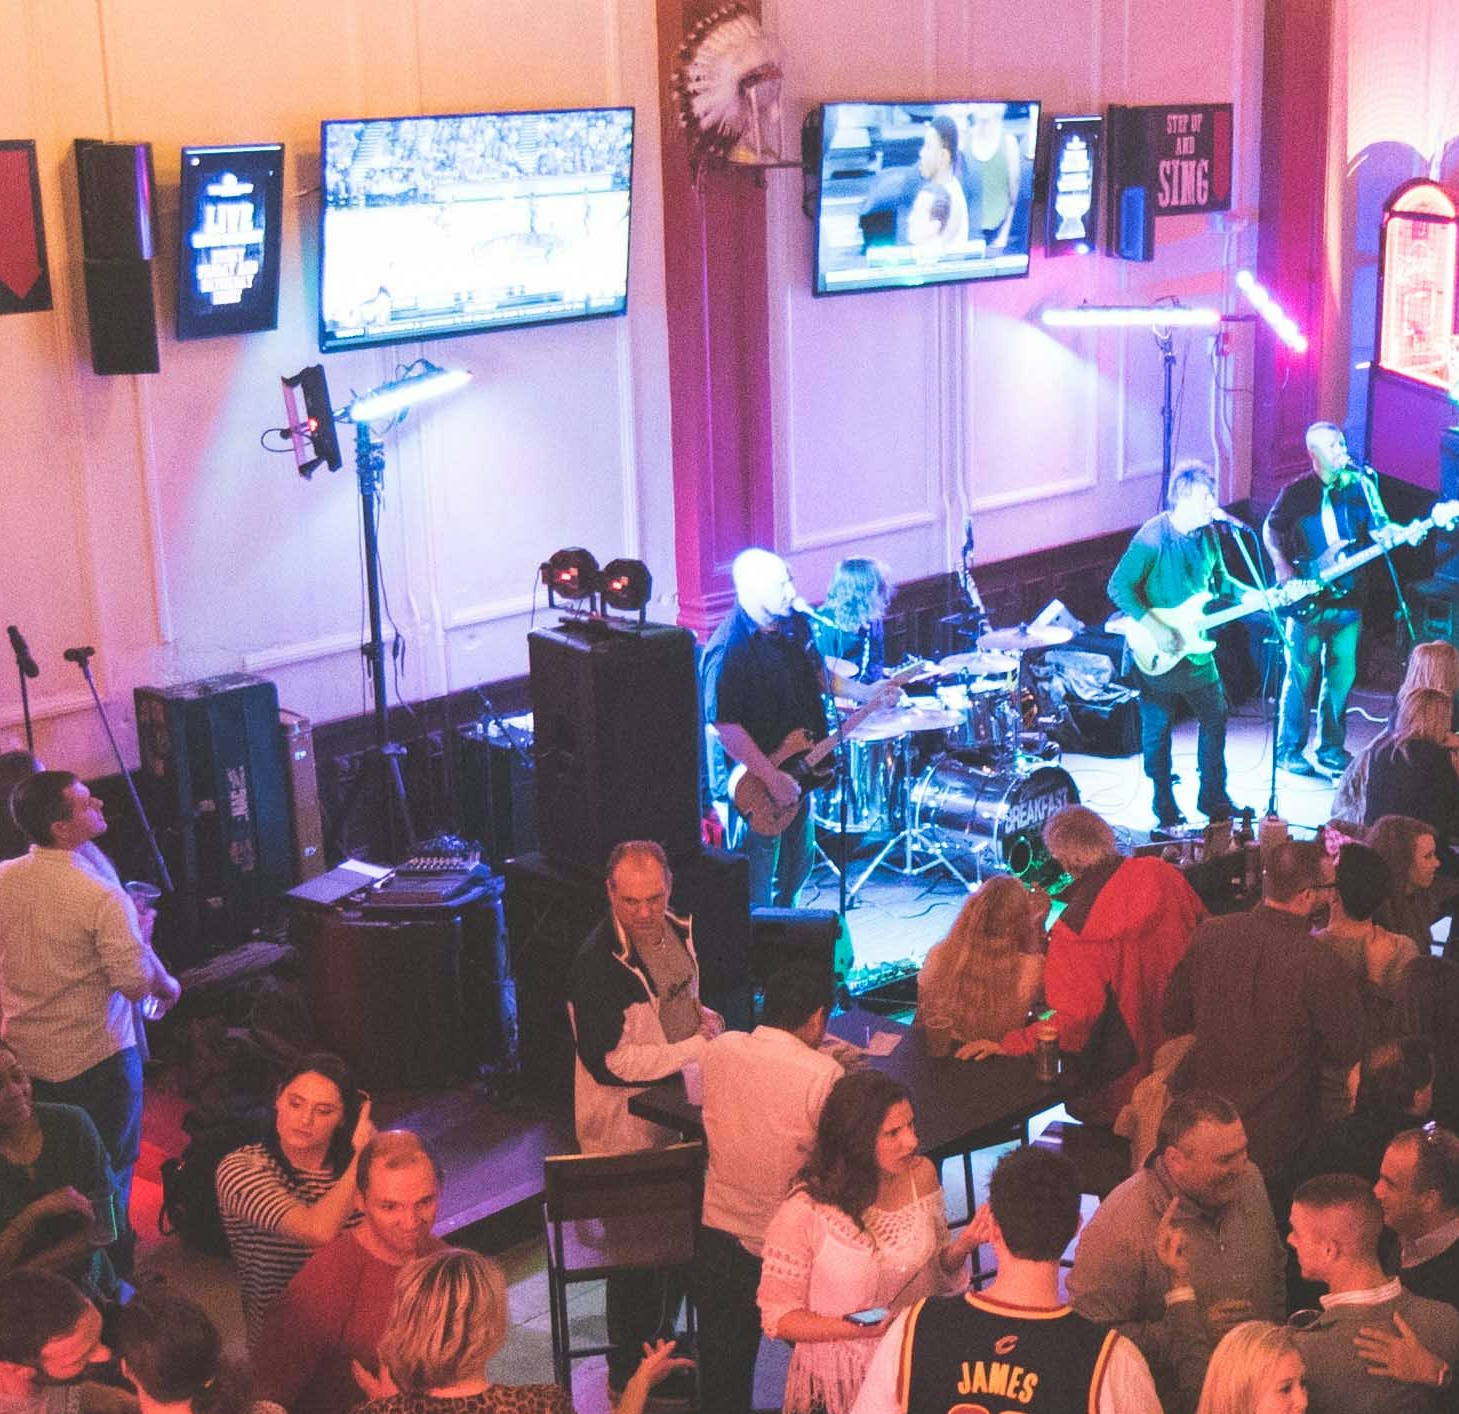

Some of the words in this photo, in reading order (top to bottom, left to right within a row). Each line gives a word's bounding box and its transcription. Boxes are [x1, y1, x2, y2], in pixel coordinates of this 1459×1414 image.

[1166, 113, 1189, 134] STEP
[1191, 113, 1203, 132] UP
[1175, 136, 1196, 155] AND
[1157, 159, 1209, 207] SING
[957, 1360, 1039, 1404] JAMES
